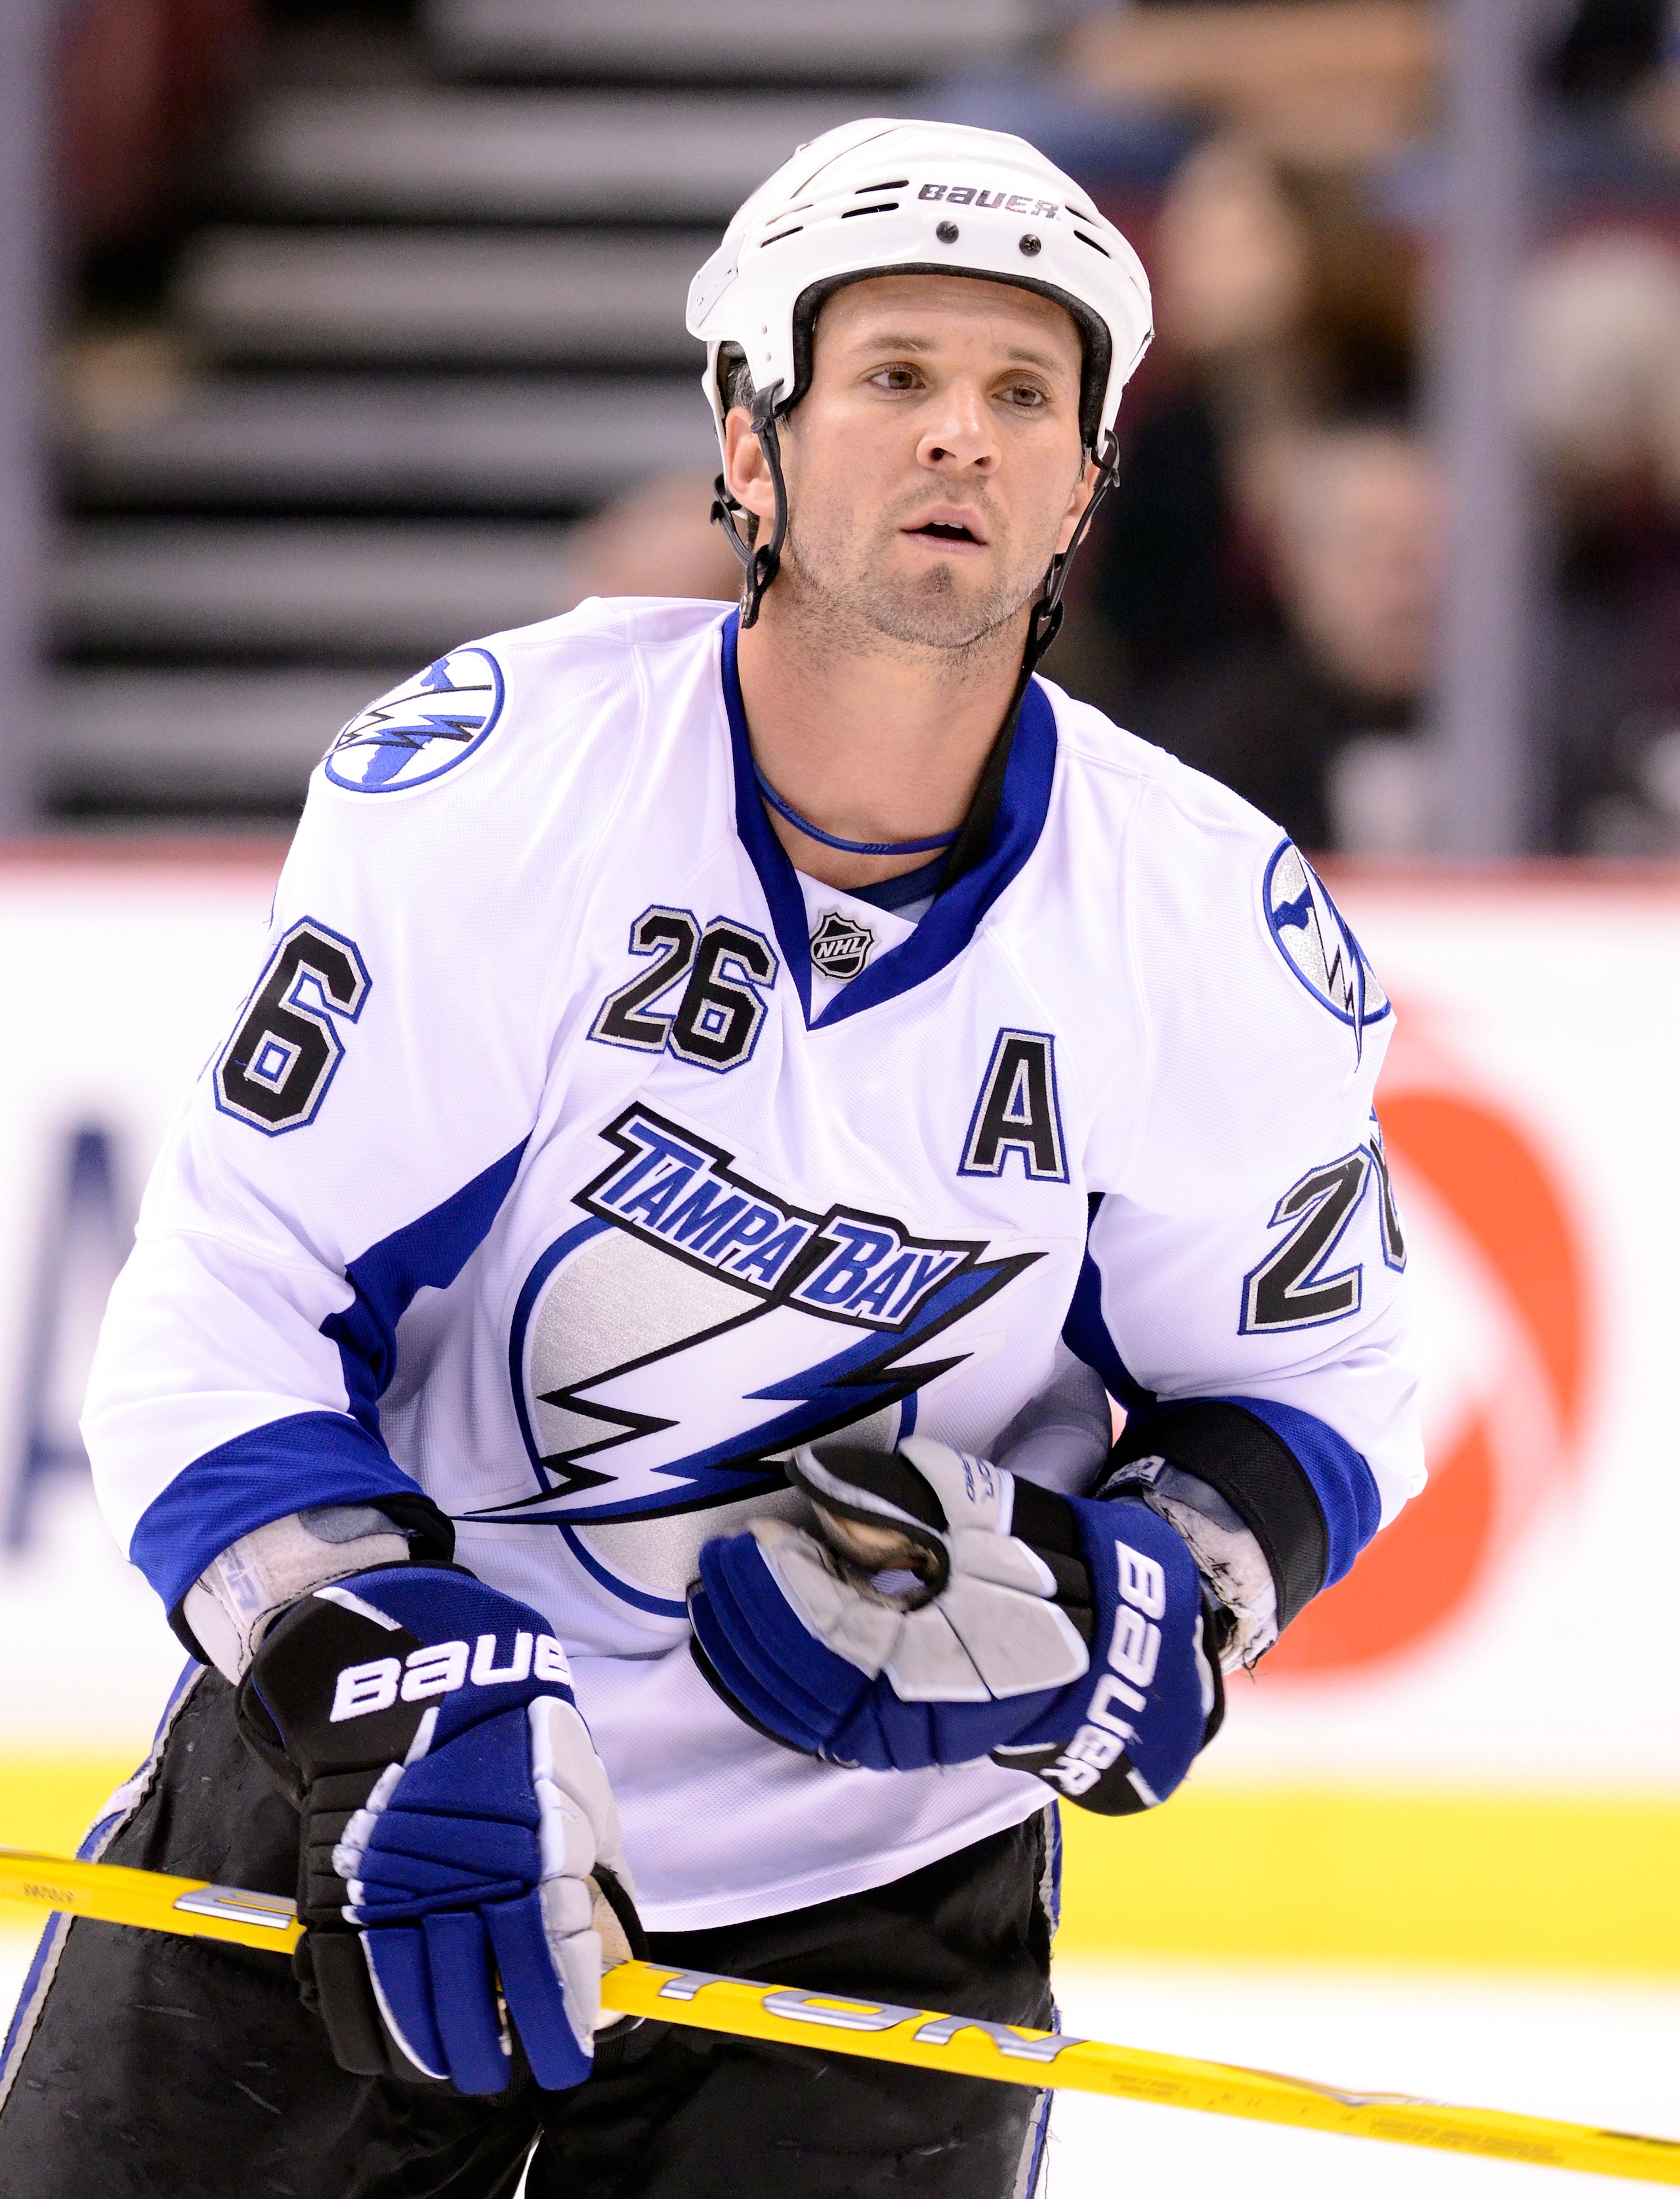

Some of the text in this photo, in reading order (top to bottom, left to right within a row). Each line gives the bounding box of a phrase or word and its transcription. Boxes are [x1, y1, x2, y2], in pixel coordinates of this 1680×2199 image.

[586, 904, 780, 1075] 26
[816, 937, 862, 959] NHL
[957, 1027, 1070, 1184] A
[329, 1631, 575, 1723] BAUE
